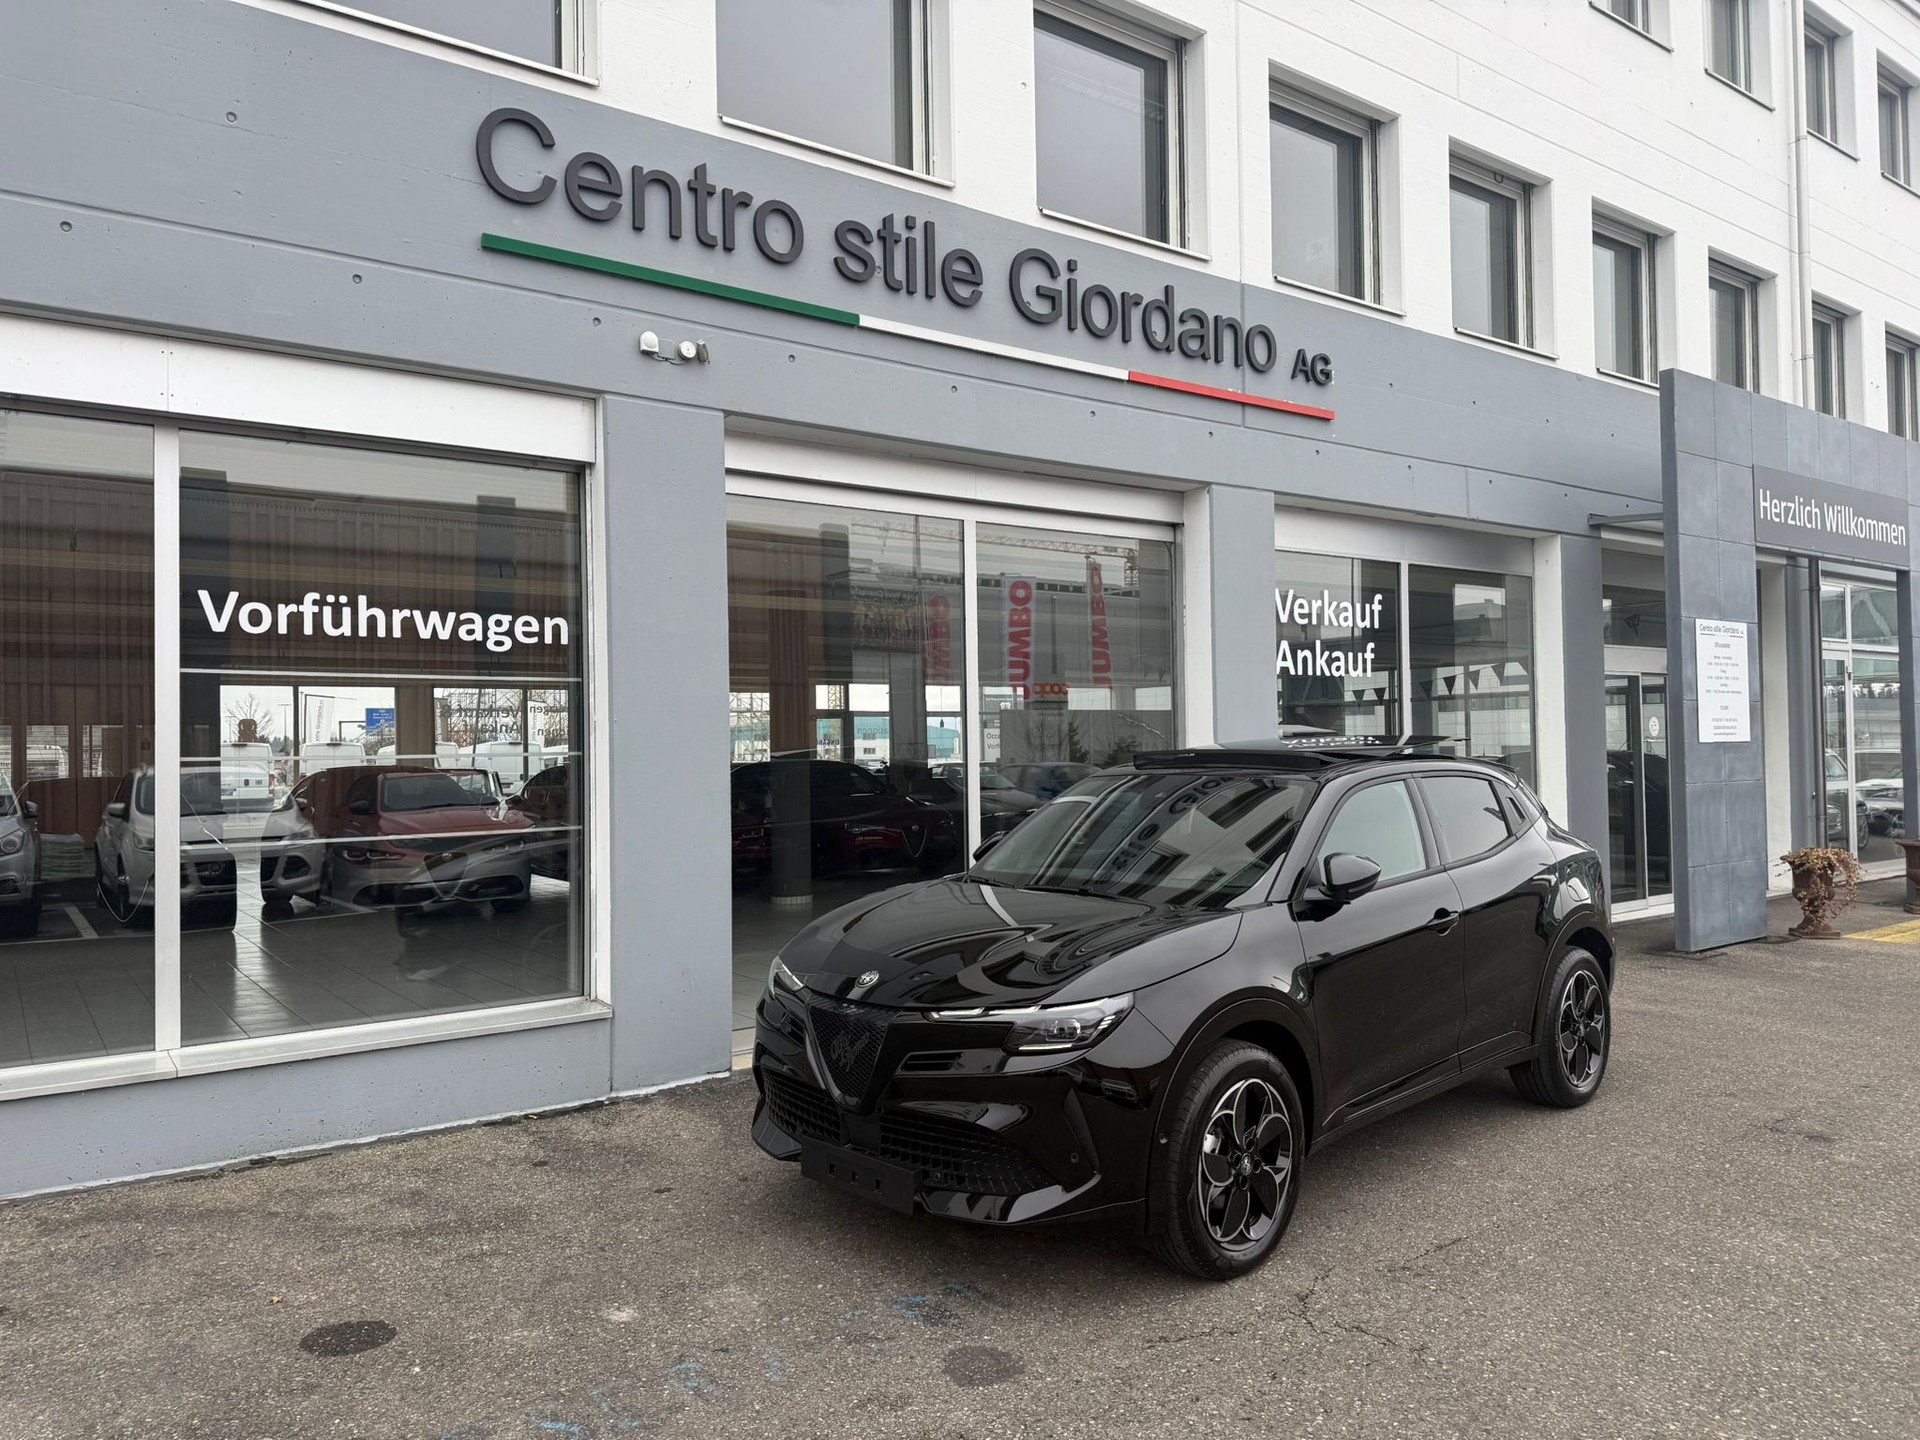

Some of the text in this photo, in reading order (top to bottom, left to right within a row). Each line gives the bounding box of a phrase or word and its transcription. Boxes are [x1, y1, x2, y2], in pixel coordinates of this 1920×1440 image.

[476, 106, 1334, 386] Centro stile Giordano AG
[1759, 488, 1906, 547] Herzlich Willkommen
[197, 588, 569, 653] Vorführwagen
[1275, 587, 1383, 629] Verkauf
[1008, 579, 1034, 700] JUMBO
[1276, 639, 1376, 678] Ankauf
